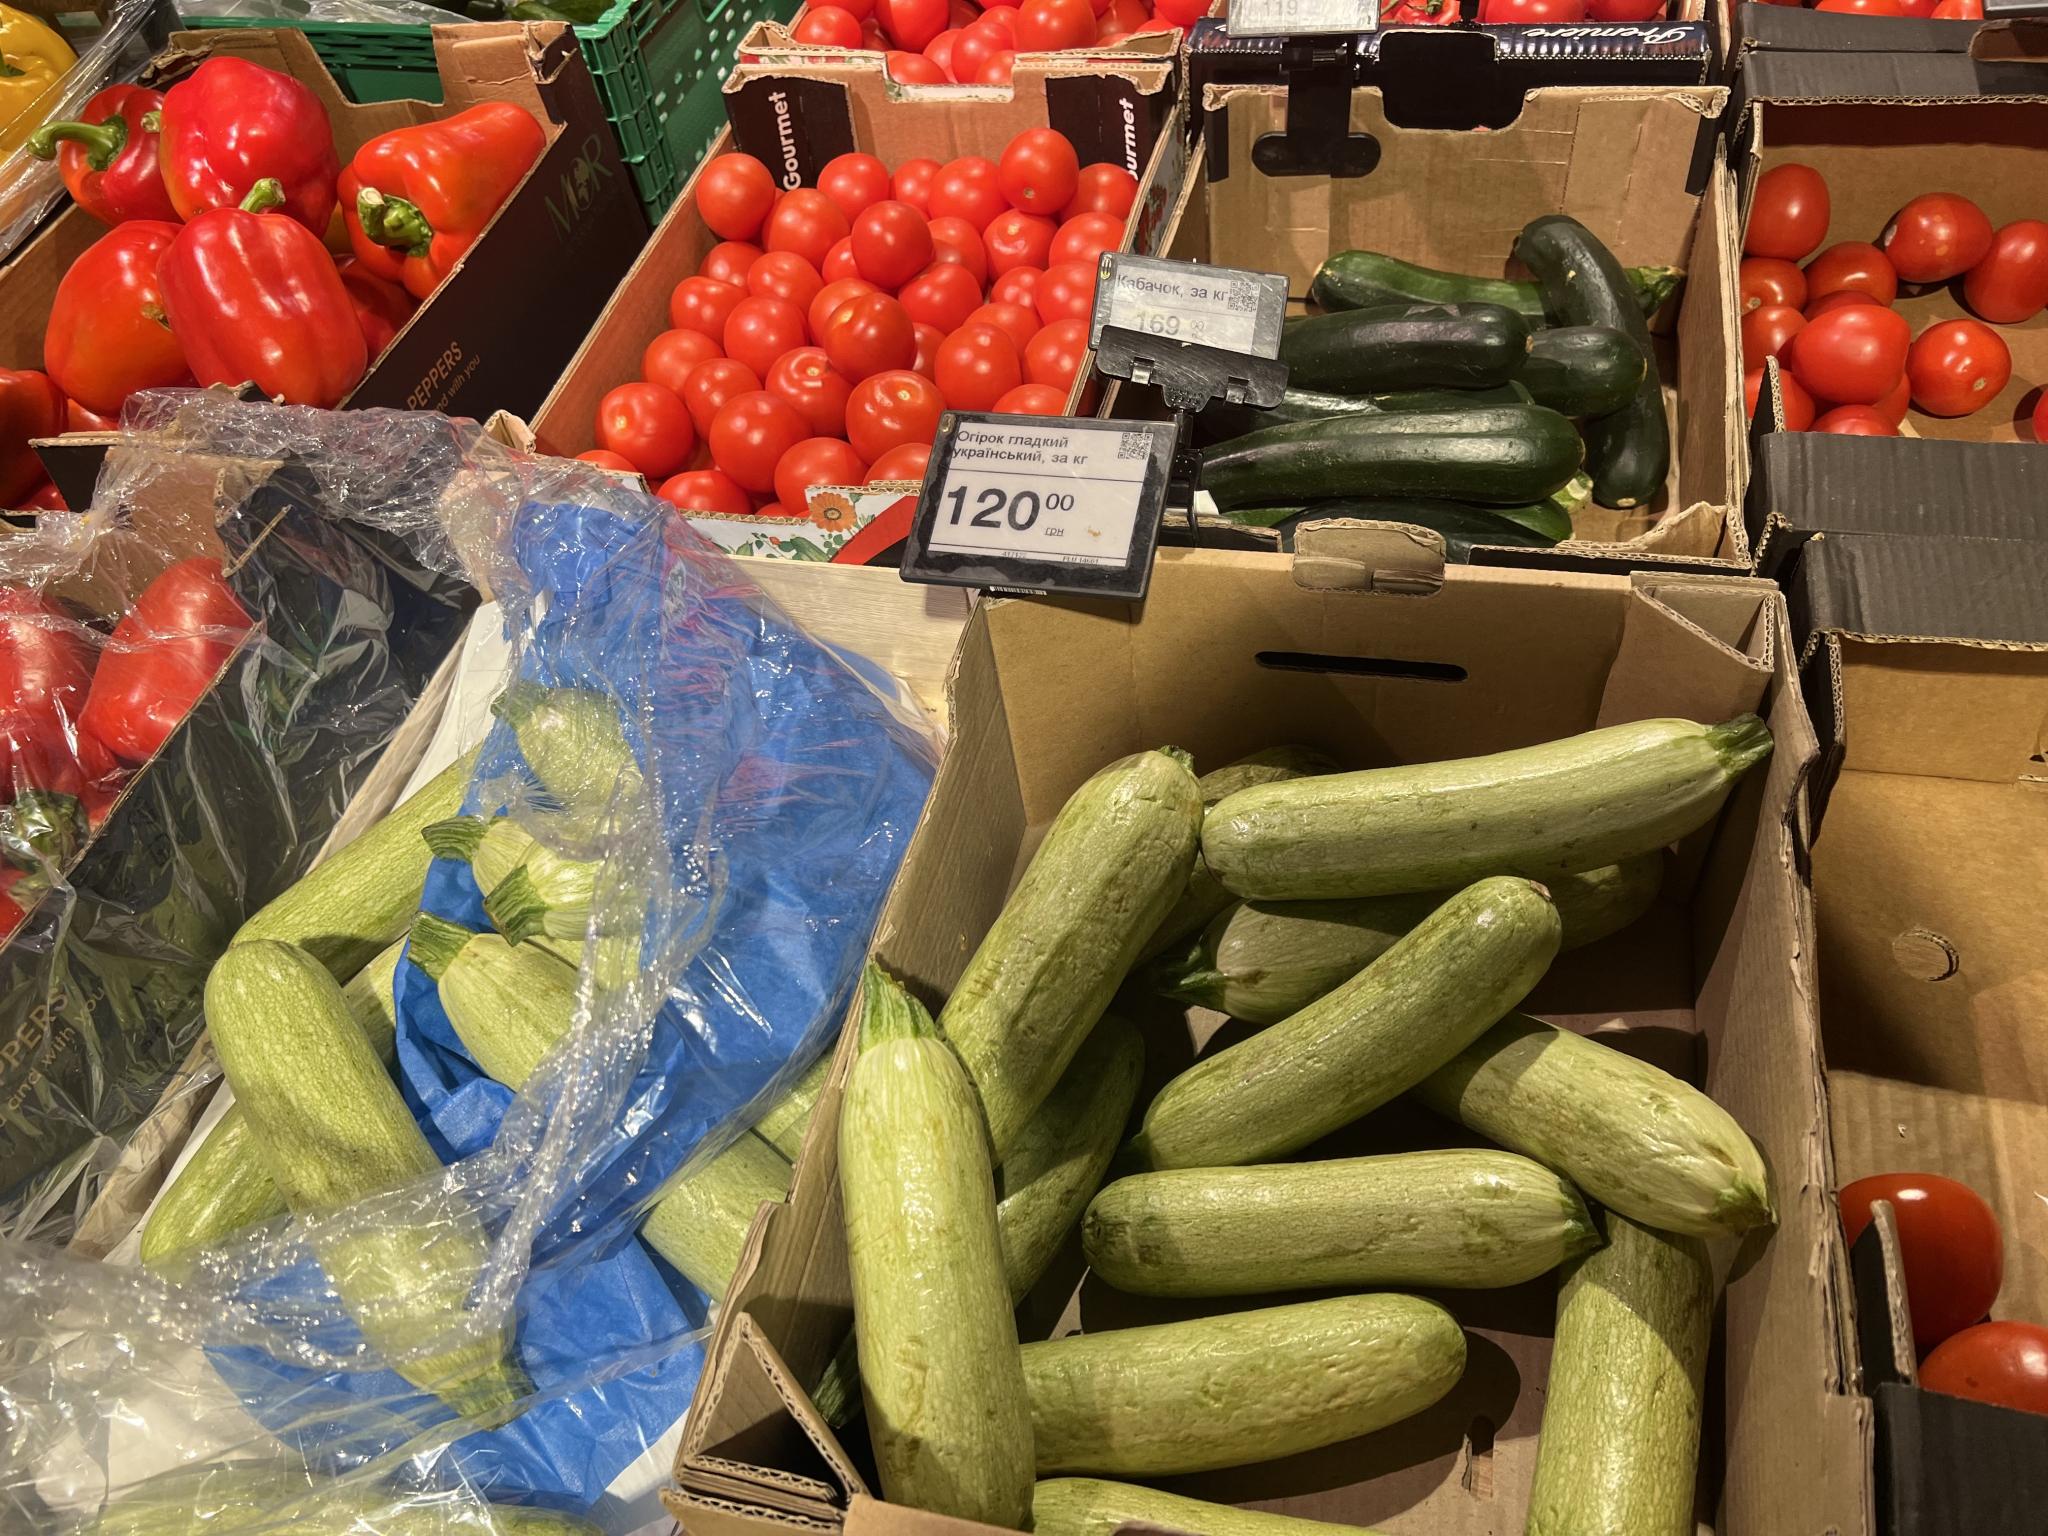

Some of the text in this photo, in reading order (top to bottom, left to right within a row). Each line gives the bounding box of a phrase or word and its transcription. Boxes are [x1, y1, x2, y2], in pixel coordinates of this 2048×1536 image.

[768, 91, 801, 190] Gourmet
[1117, 274, 1228, 301] Кабачок, за кг
[1137, 311, 1180, 335] 169
[407, 341, 462, 411] PEPPERS
[464, 354, 480, 379] you
[958, 430, 1069, 449] Огірок гладкий
[950, 447, 1088, 466] український, за кг
[947, 485, 1074, 531] 120 00
[1045, 527, 1064, 537] грн
[41, 1027, 76, 1066] with
